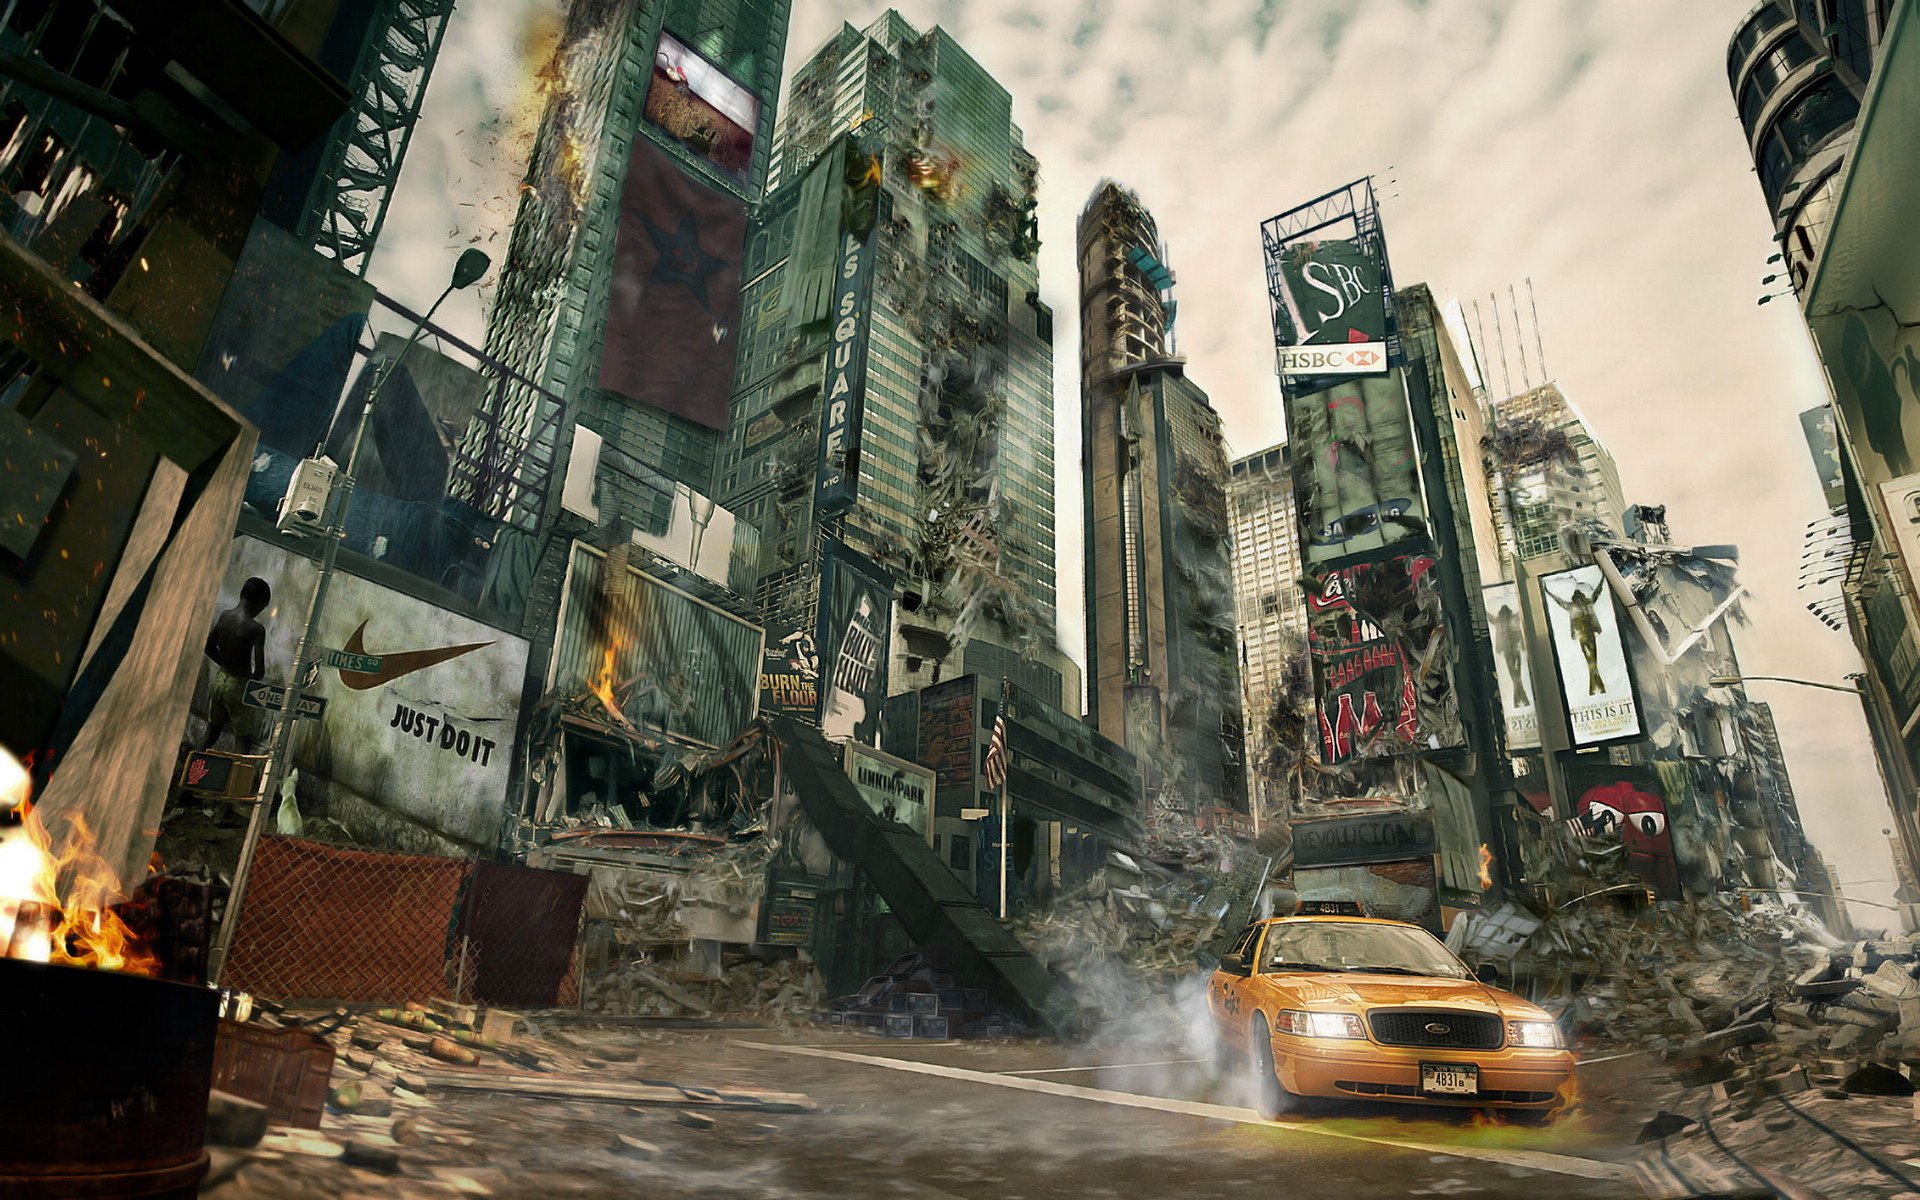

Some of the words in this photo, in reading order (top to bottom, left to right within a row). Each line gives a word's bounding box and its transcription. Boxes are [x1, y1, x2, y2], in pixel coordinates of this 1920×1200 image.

[1281, 351, 1342, 369] HSBC
[823, 475, 839, 488] NYC
[841, 624, 876, 666] BILLY
[329, 652, 364, 670] TIMES
[760, 673, 800, 690] BURN
[800, 682, 815, 691] THE
[258, 690, 282, 704] ONE
[295, 701, 318, 711] AY
[772, 688, 818, 706] FLOOR
[1570, 708, 1602, 723] THIS
[1605, 705, 1617, 718] IS
[1619, 702, 1632, 715] IT
[390, 703, 440, 743] JUST
[440, 722, 471, 757] DO
[471, 735, 496, 767] IT
[858, 765, 895, 795] LINKIN
[895, 780, 925, 806] PARK
[1319, 903, 1339, 914] 4B31
